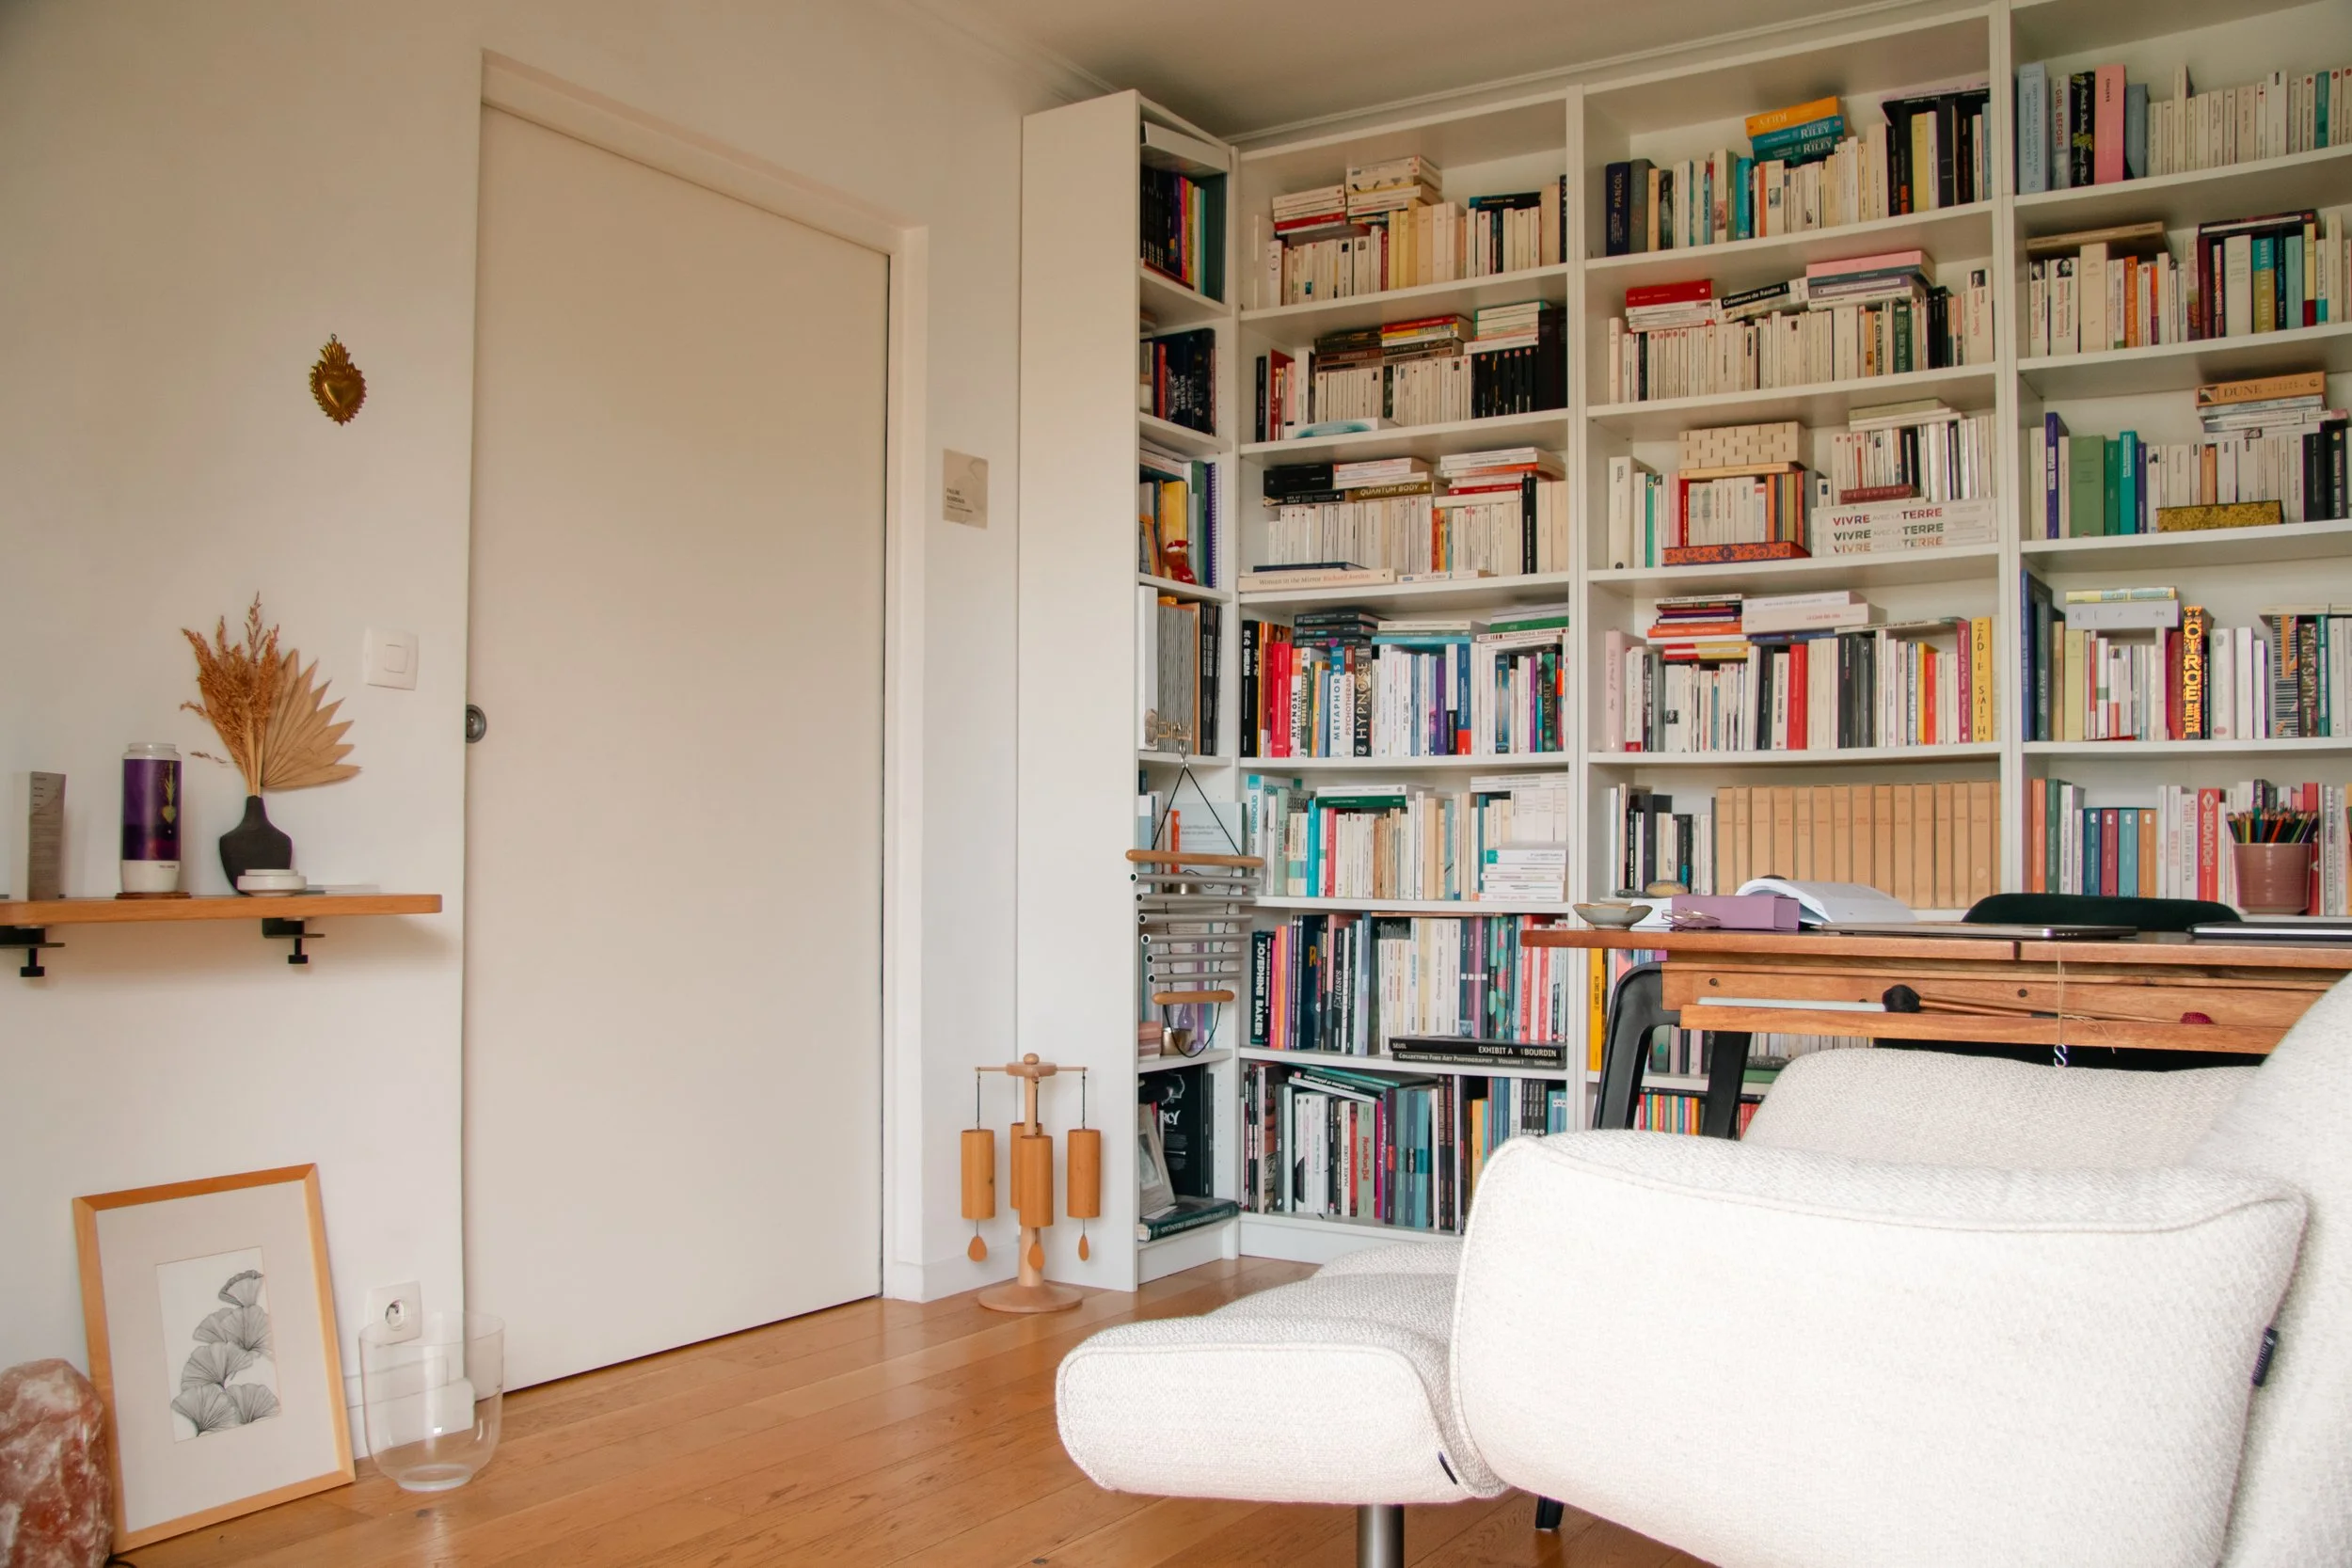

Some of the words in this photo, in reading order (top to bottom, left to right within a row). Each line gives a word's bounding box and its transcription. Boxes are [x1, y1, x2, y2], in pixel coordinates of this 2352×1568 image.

[1801, 124, 1829, 139] RILEY
[1804, 139, 1832, 154] RILEY
[1613, 172, 1622, 208] PANCOL
[2224, 385, 2262, 397] DUNE
[1360, 487, 1396, 496] QUANTUM
[1834, 515, 1871, 526] VIVRE
[1901, 508, 1943, 520] TERRE
[1834, 530, 1871, 541] VIVRE
[1902, 523, 1944, 535] TERRE
[1834, 542, 1871, 553] VIVRE
[1902, 536, 1943, 548] TERRE
[1323, 574, 1347, 582] Richard
[1977, 623, 1985, 671] ZADIE
[1357, 661, 1368, 739] HYPNOSE
[2301, 668, 2315, 706] SMITH
[1977, 686, 1986, 735] SMITH
[2185, 703, 2194, 733] MILLER
[1249, 795, 1258, 834] PERNOUD
[2202, 811, 2214, 865] POUVOIR
[1256, 942, 1265, 996] JOSEPHINE
[1334, 970, 1343, 1008] Extases
[1255, 1000, 1263, 1036] BAKER
[1478, 1046, 1505, 1054] EXHIBIT
